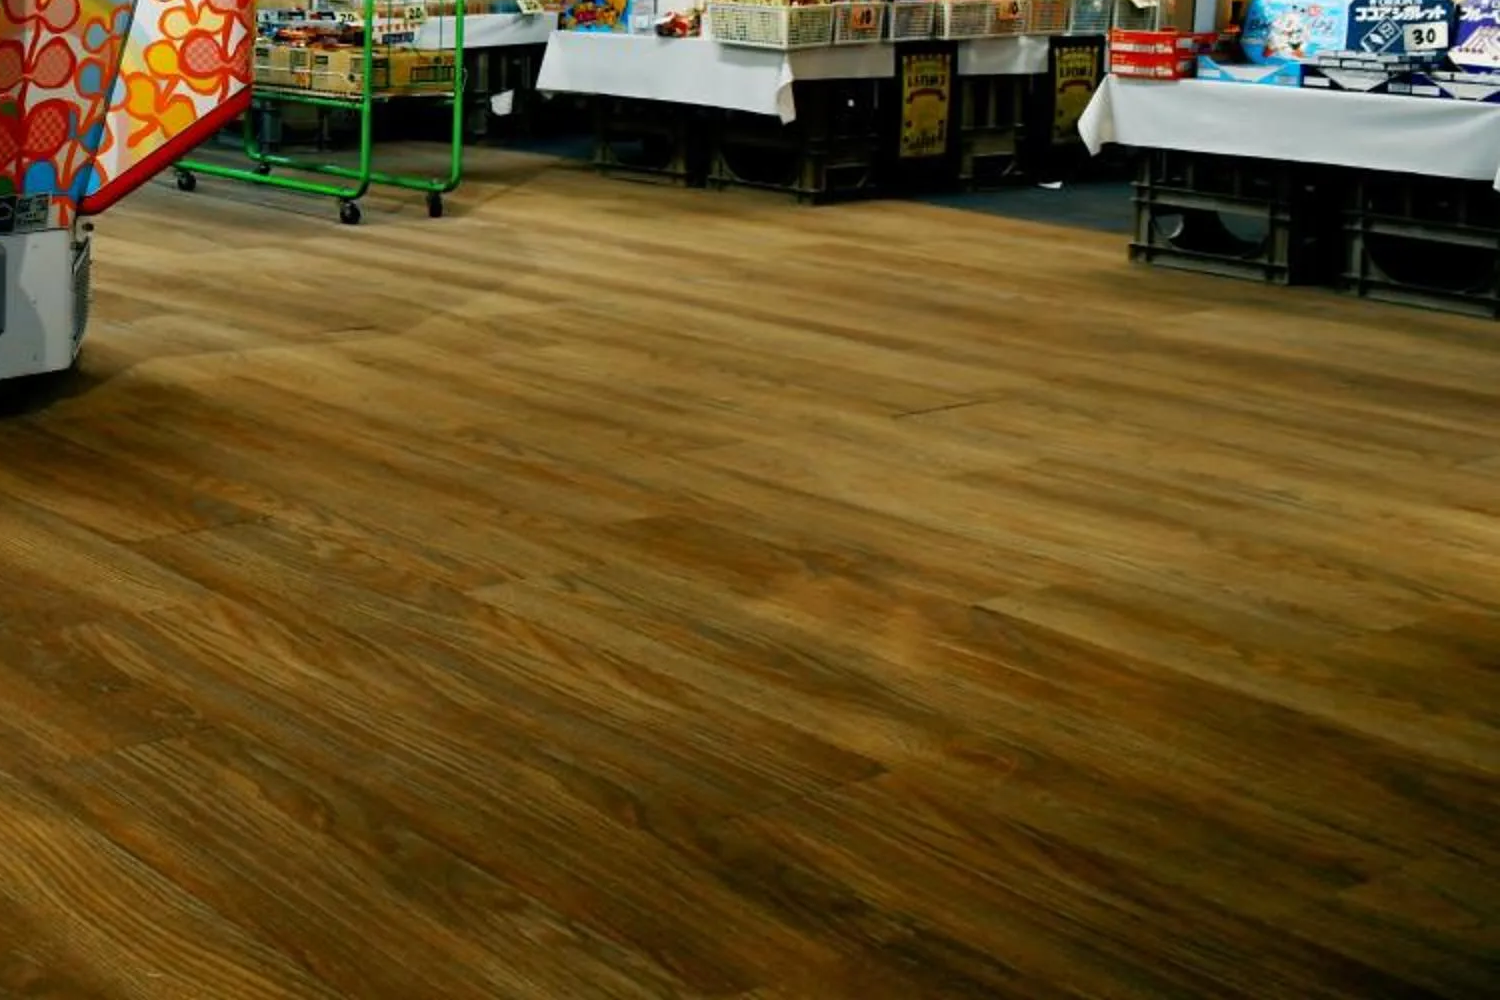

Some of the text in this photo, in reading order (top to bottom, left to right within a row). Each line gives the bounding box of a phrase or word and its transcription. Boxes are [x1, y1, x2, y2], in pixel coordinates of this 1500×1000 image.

[1355, 5, 1447, 21] ココアシガレット
[1412, 28, 1436, 45] 30
